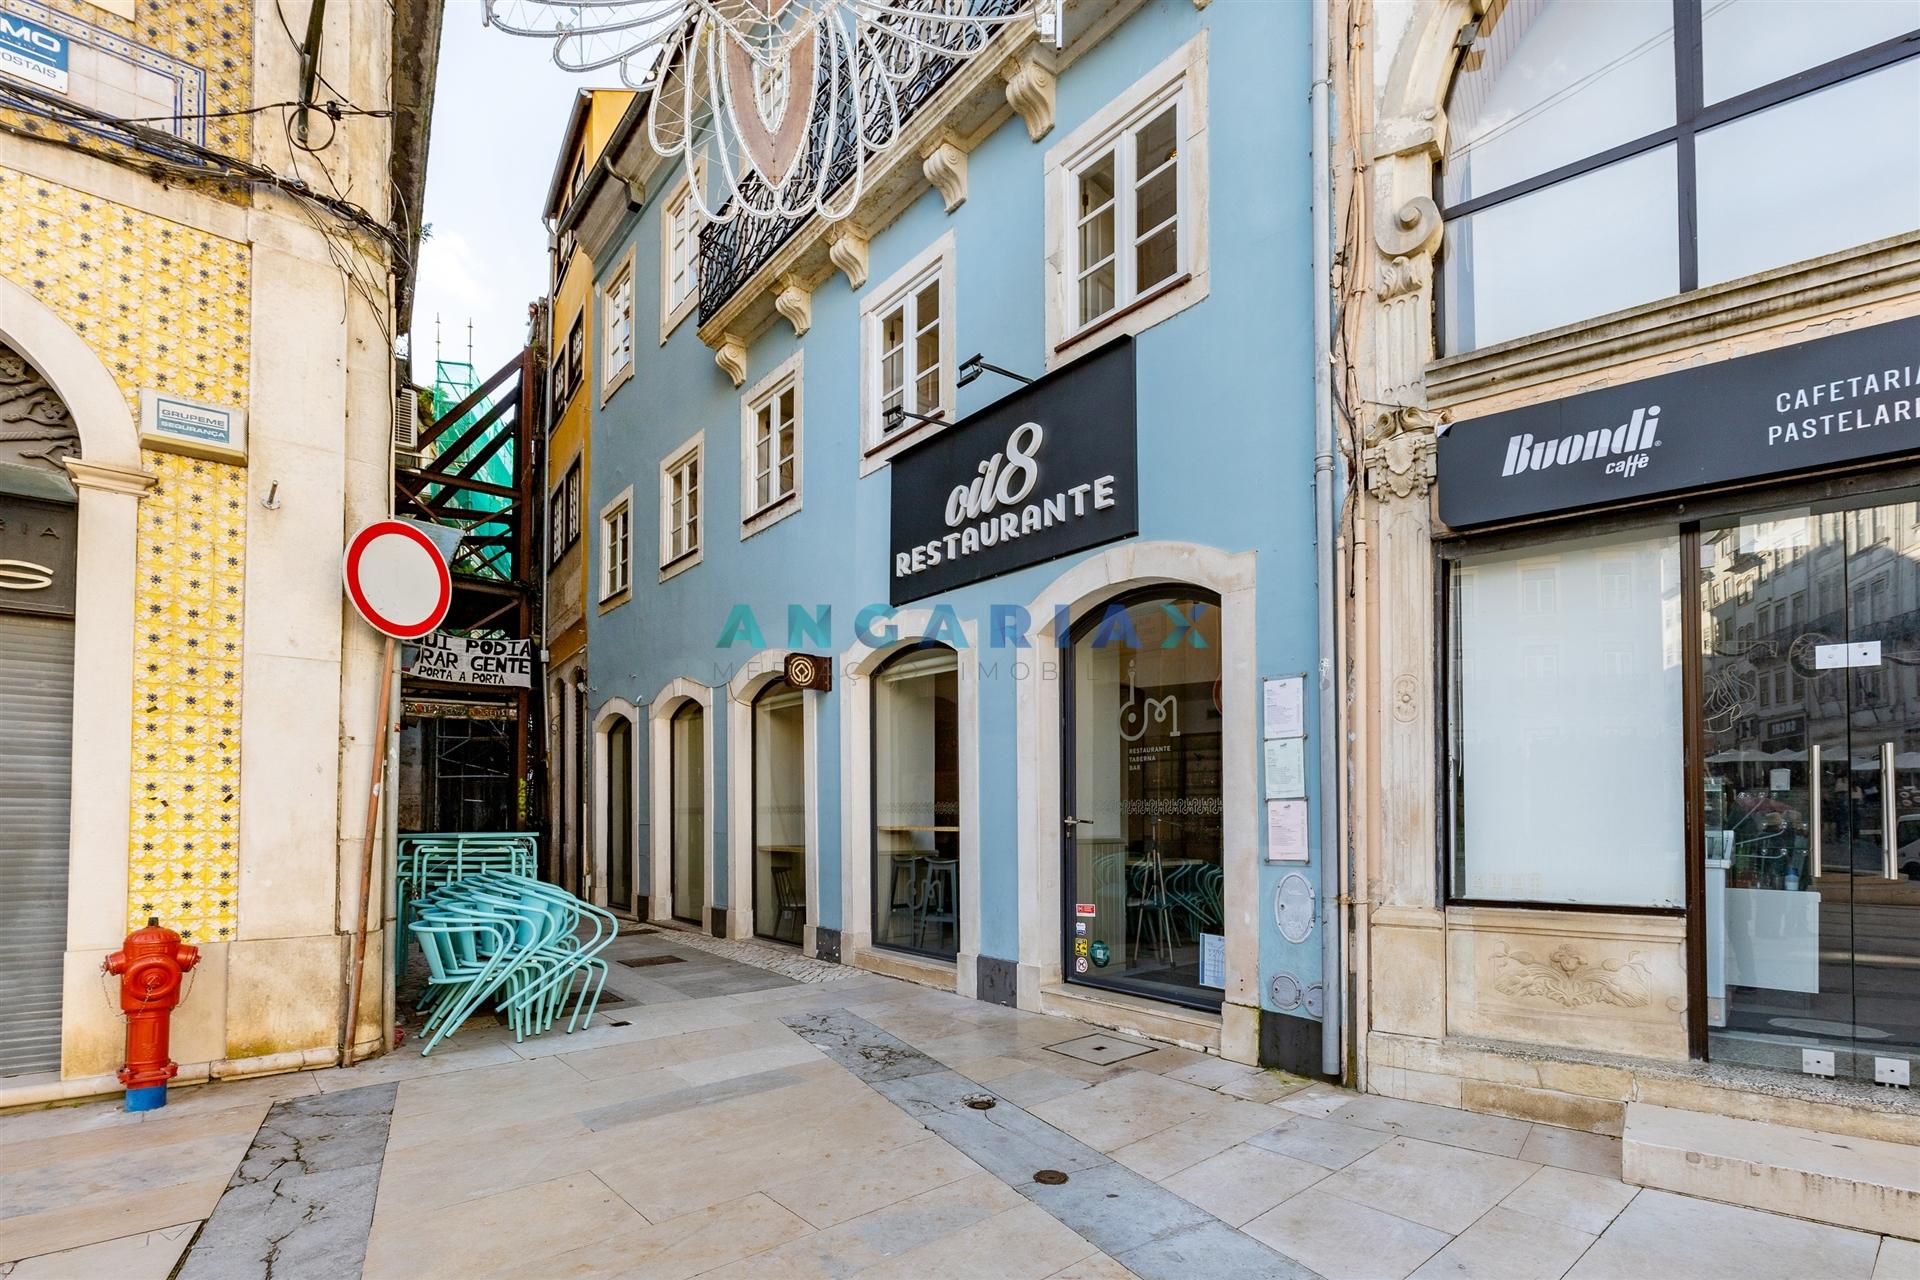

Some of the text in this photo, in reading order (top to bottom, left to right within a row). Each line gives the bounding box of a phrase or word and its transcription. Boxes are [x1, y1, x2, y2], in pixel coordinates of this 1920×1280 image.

[1776, 365, 1920, 413] CAFETARI
[161, 409, 225, 427] GRUPEME
[160, 420, 226, 438] SEGURANÇA
[1501, 405, 1661, 478] Buondi
[1604, 453, 1650, 478] caffè
[896, 474, 1116, 577] RESTAURANTE
[465, 639, 531, 658] PODIA
[418, 665, 505, 685] PORTA A PORTA
[470, 655, 531, 675] GENTE
[1129, 745, 1172, 754] RESTAURANTE
